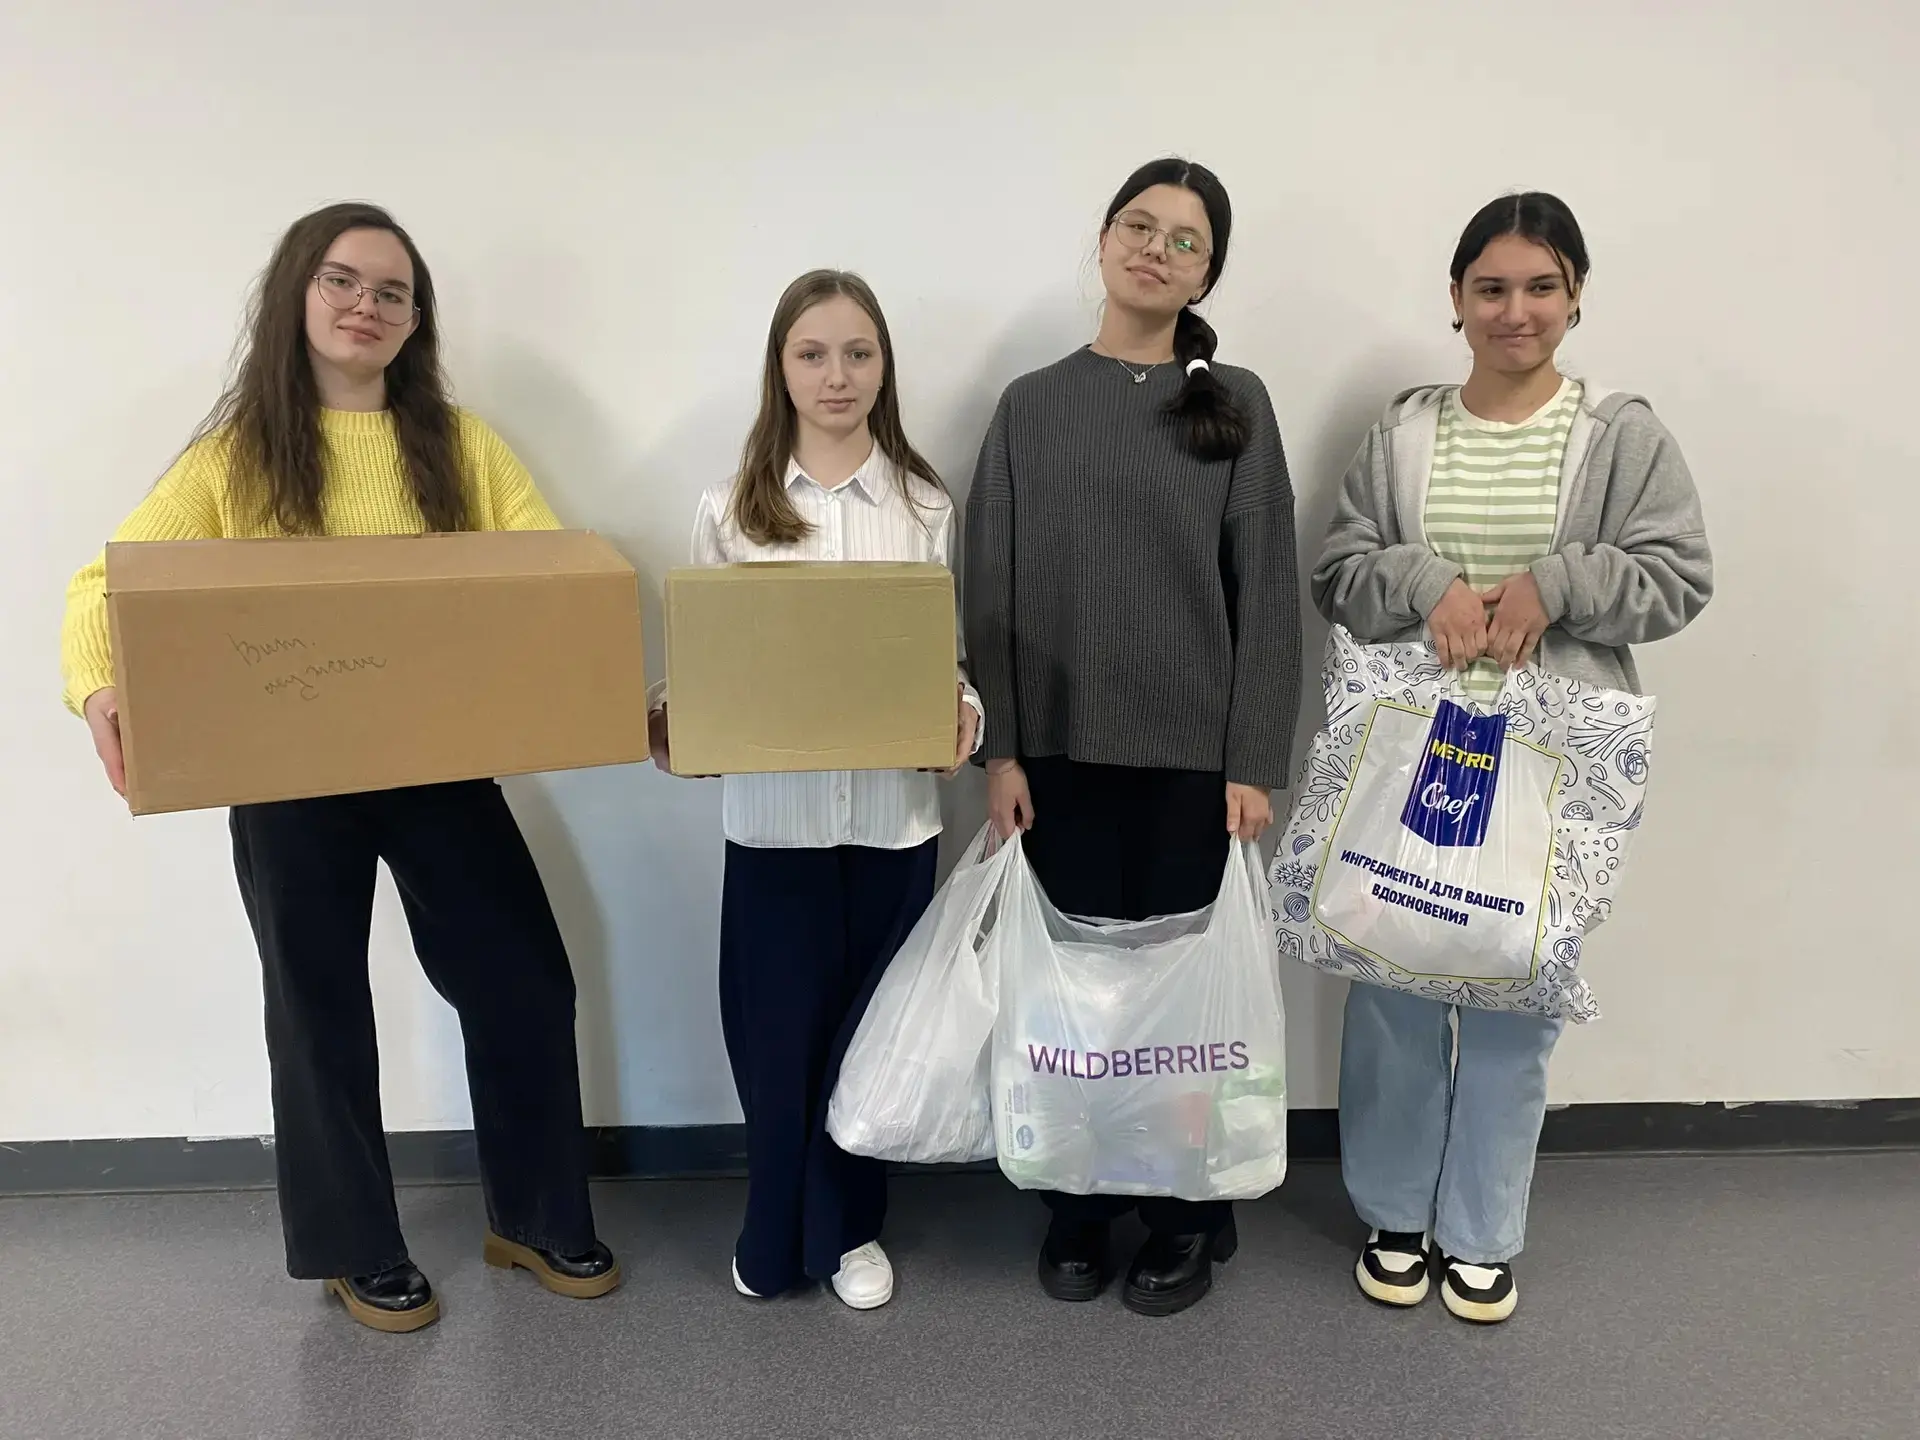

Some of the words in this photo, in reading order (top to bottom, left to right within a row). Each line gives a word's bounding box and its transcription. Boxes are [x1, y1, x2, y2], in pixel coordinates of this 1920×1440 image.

[1430, 739, 1495, 773] METRO
[1420, 782, 1480, 824] Chef
[1340, 849, 1430, 892] ИНГРЕДИЕНТЫ
[1429, 881, 1463, 902] ДЛЯ
[1464, 891, 1525, 916] ВАШЕГО
[1371, 883, 1470, 927] ВДОХНОВЕНИЯ
[1027, 1040, 1251, 1080] WILDBERRIES
